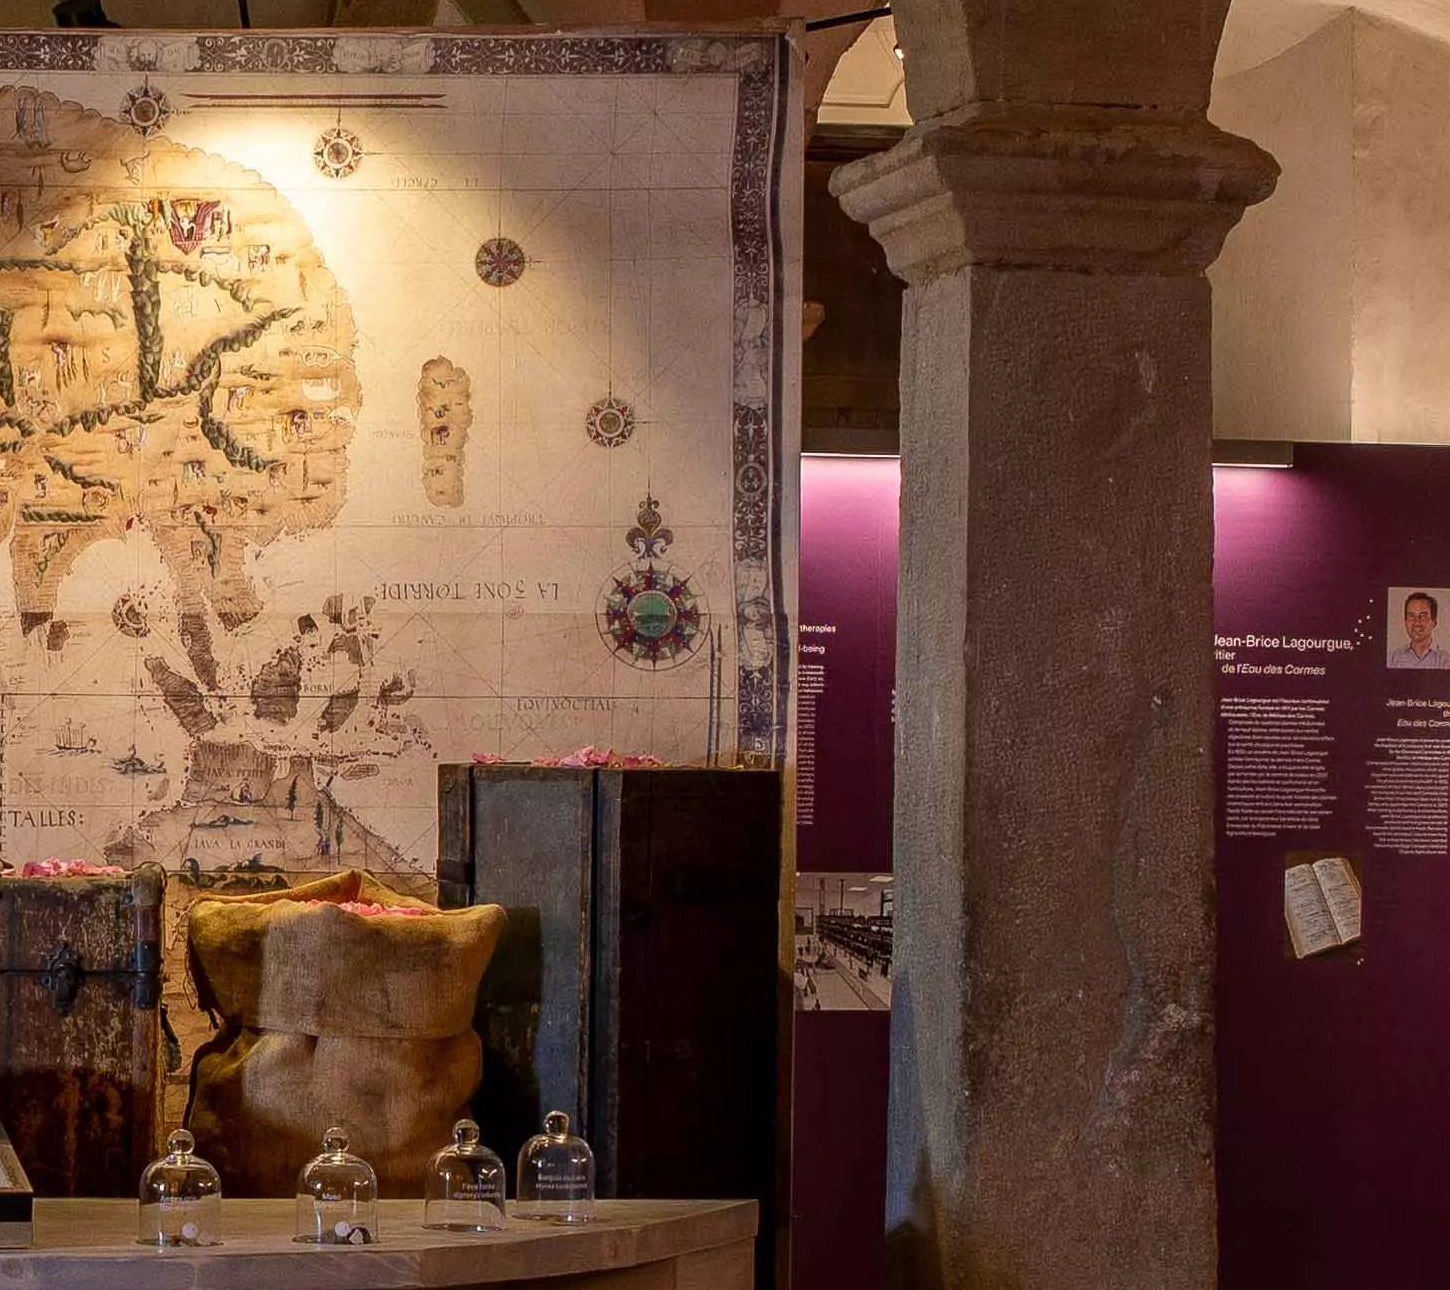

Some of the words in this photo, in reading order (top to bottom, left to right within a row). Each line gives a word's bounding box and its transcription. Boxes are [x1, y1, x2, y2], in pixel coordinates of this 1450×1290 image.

[1282, 635, 1354, 652] Lagourgue,
[1214, 649, 1236, 660] itier
[1221, 663, 1235, 674] de
[1263, 663, 1283, 675] des
[1284, 664, 1326, 675] Carmes
